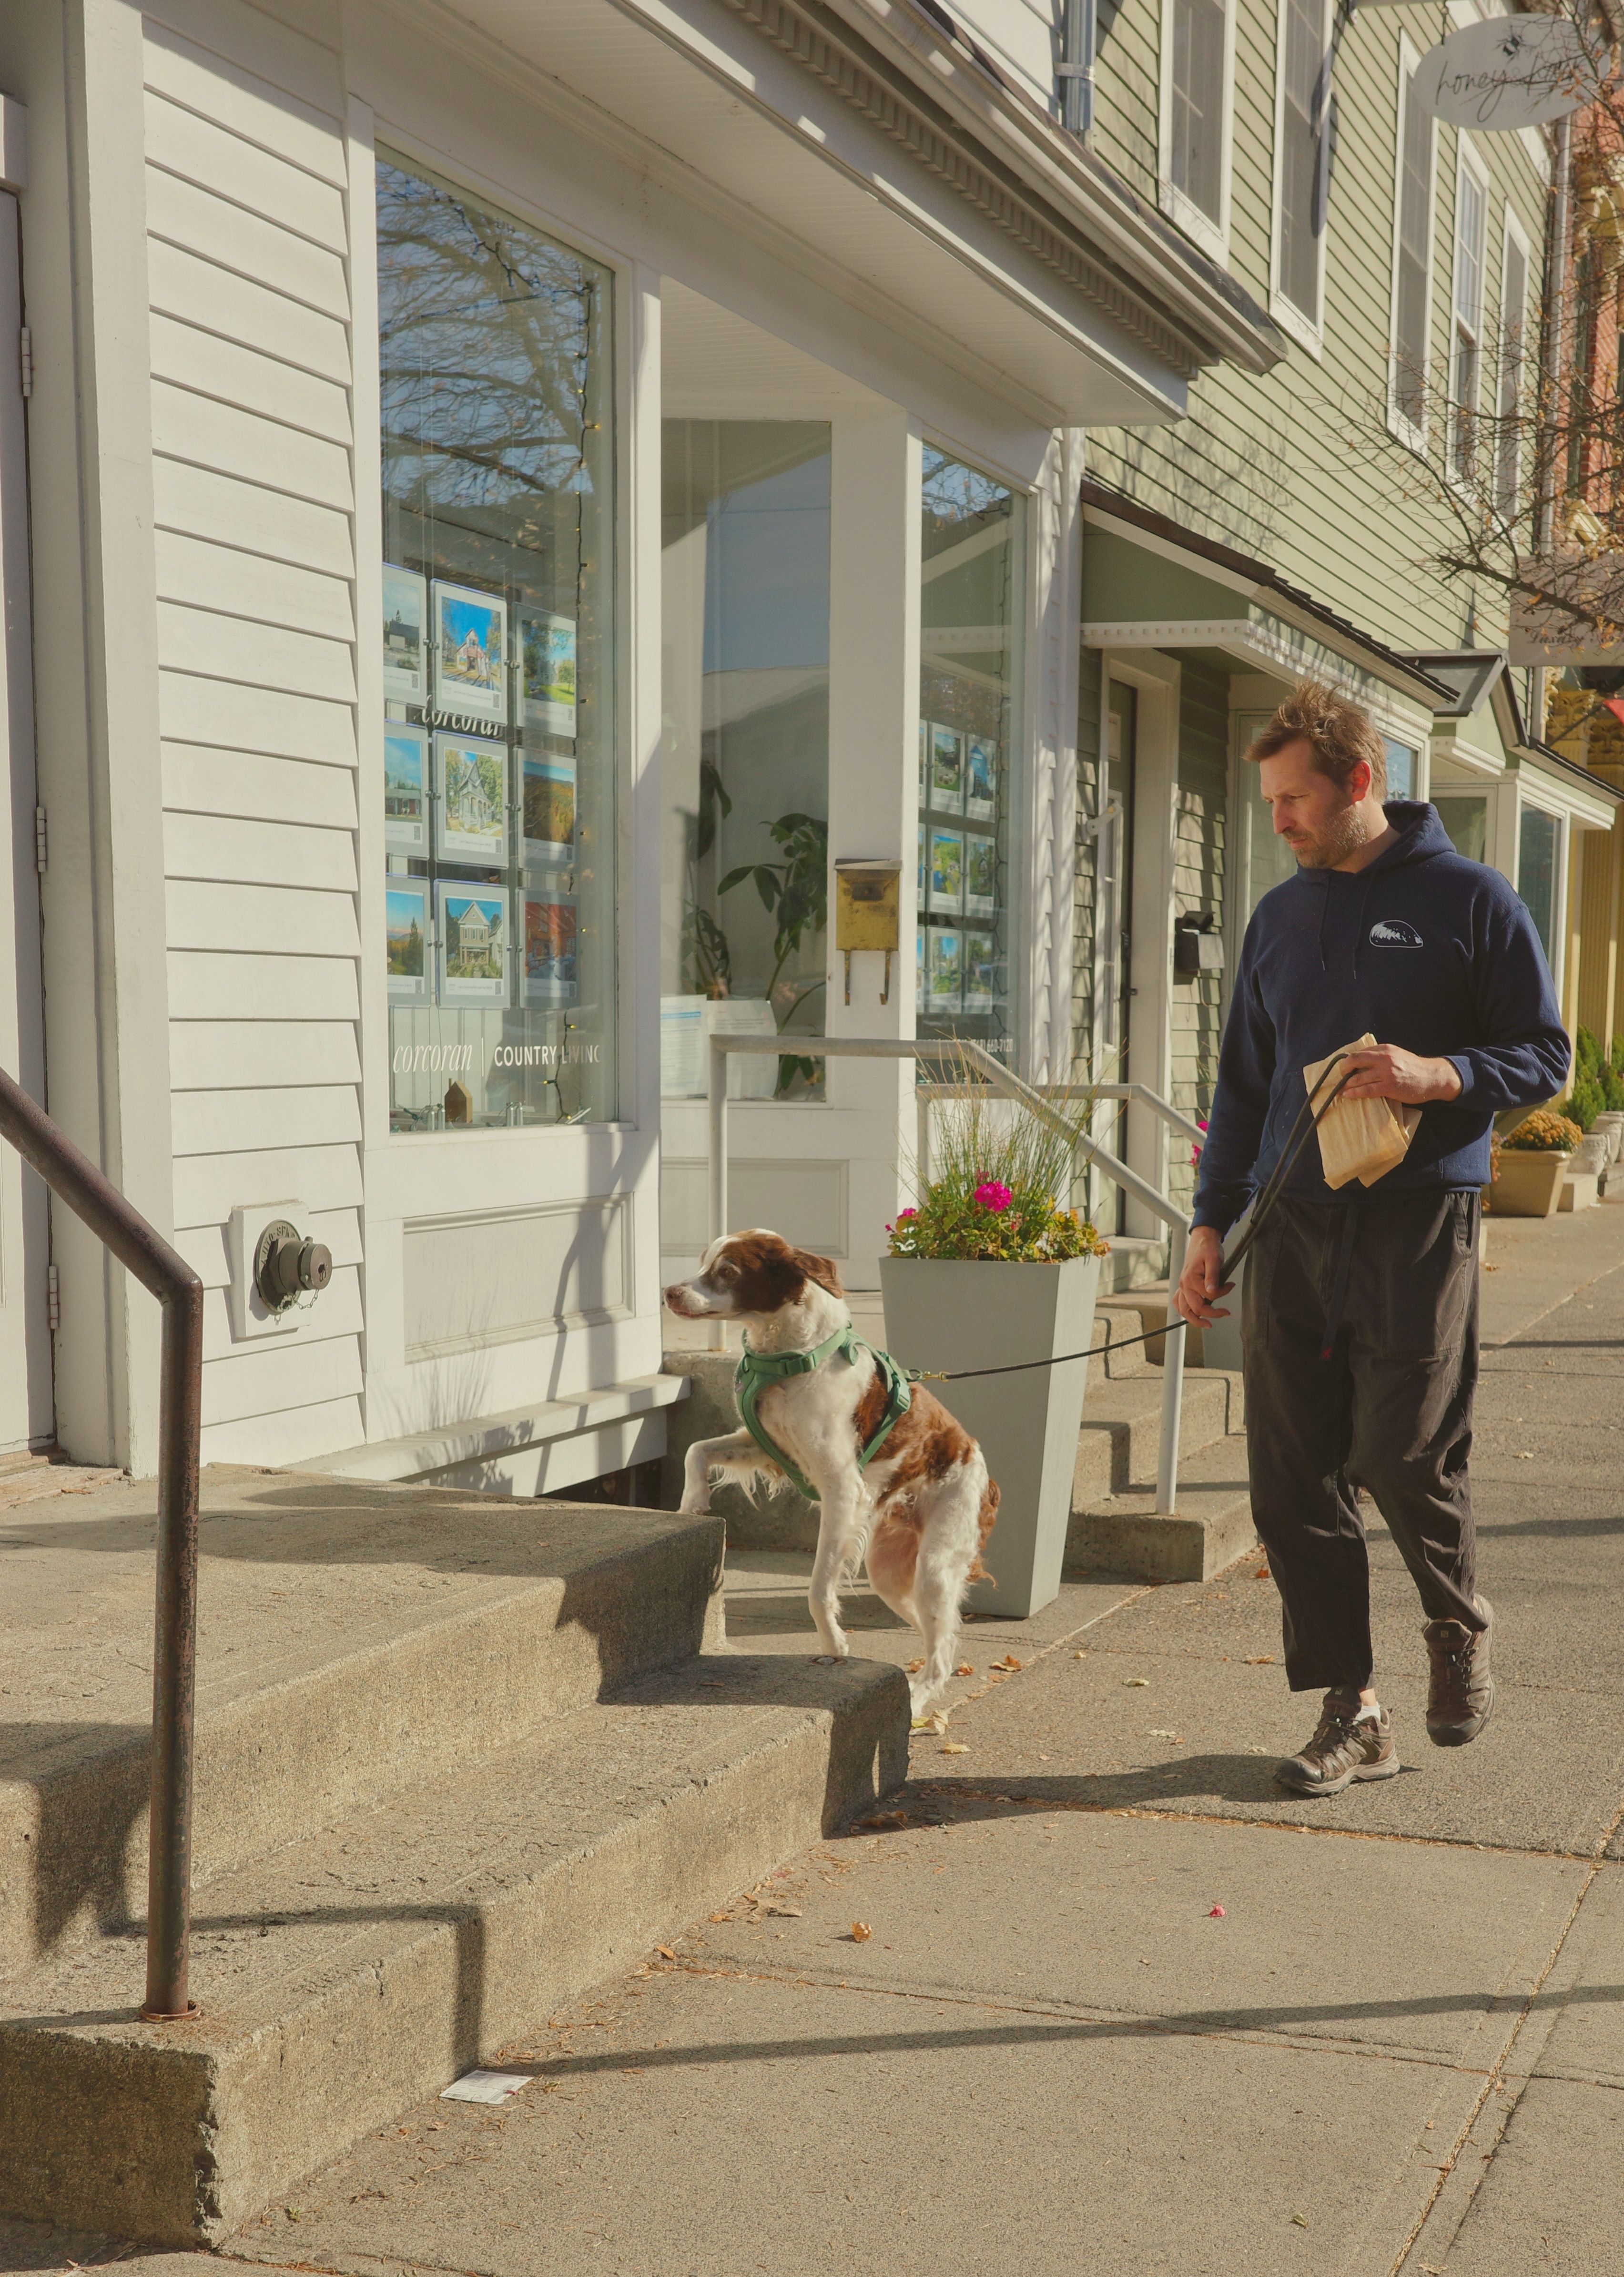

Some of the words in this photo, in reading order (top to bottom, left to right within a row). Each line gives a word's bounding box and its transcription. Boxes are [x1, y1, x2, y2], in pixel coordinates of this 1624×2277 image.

[1435, 61, 1506, 122] honey
[393, 1044, 473, 1073] corcoran
[494, 1045, 557, 1067] COUNTRY
